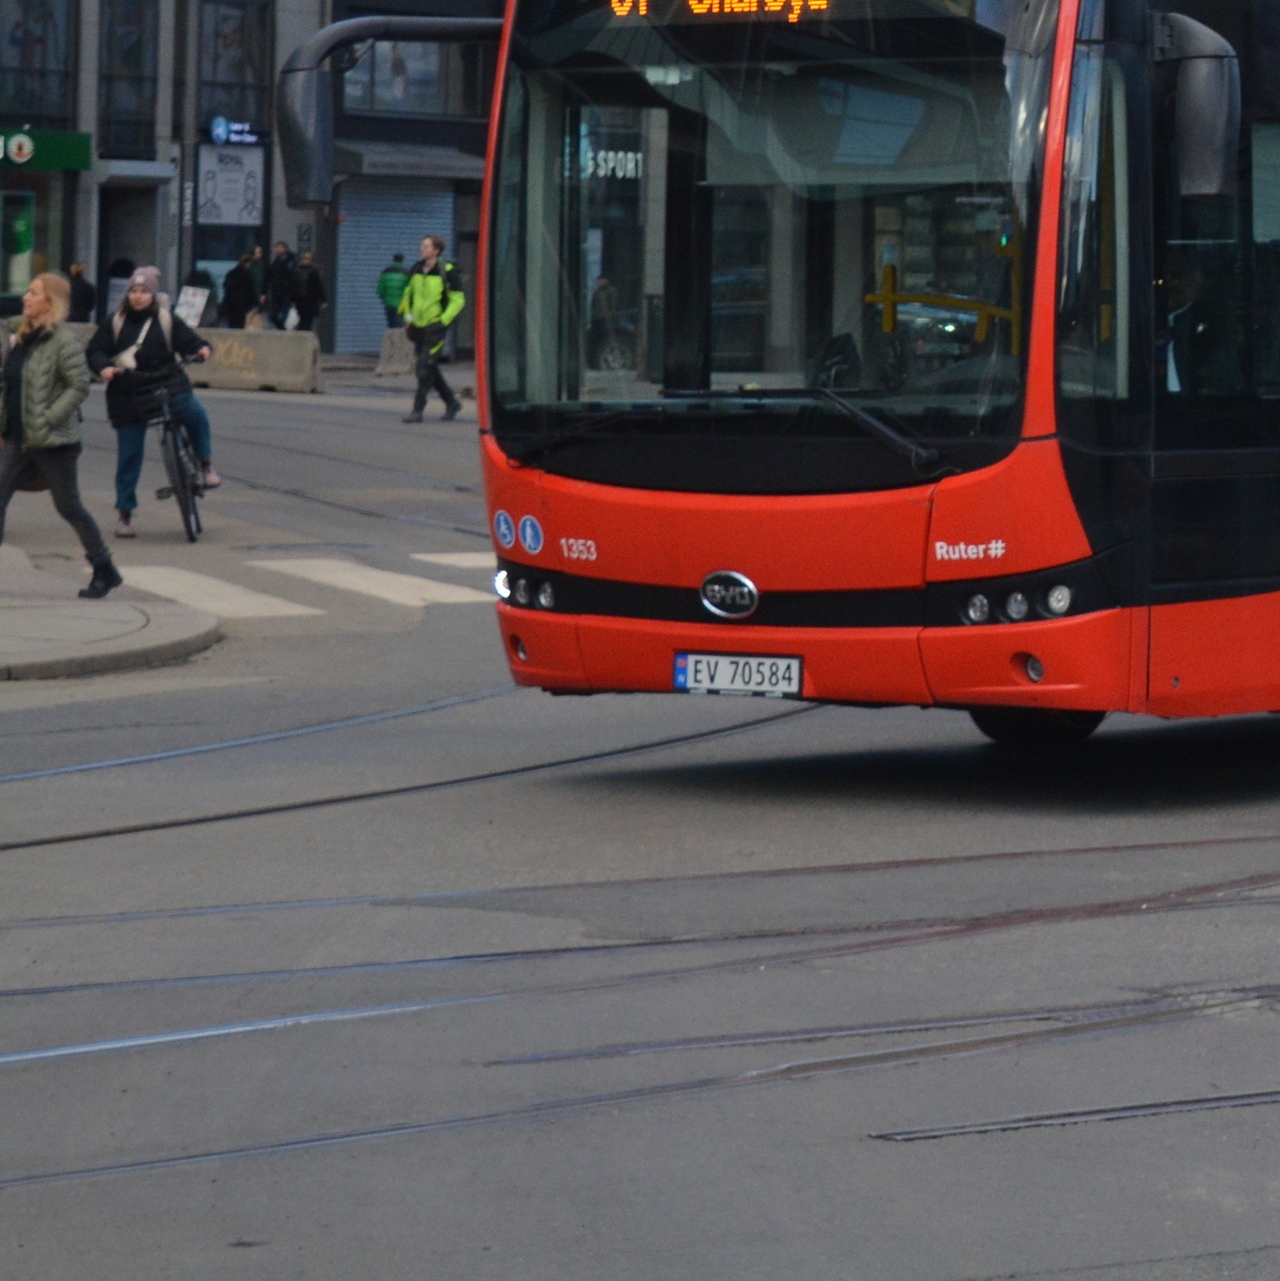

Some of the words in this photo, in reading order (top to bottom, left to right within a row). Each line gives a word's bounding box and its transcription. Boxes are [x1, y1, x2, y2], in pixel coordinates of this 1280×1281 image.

[560, 537, 597, 561] 1353
[706, 584, 751, 605] BYD
[694, 659, 719, 684] EV
[729, 660, 793, 687] 70584
